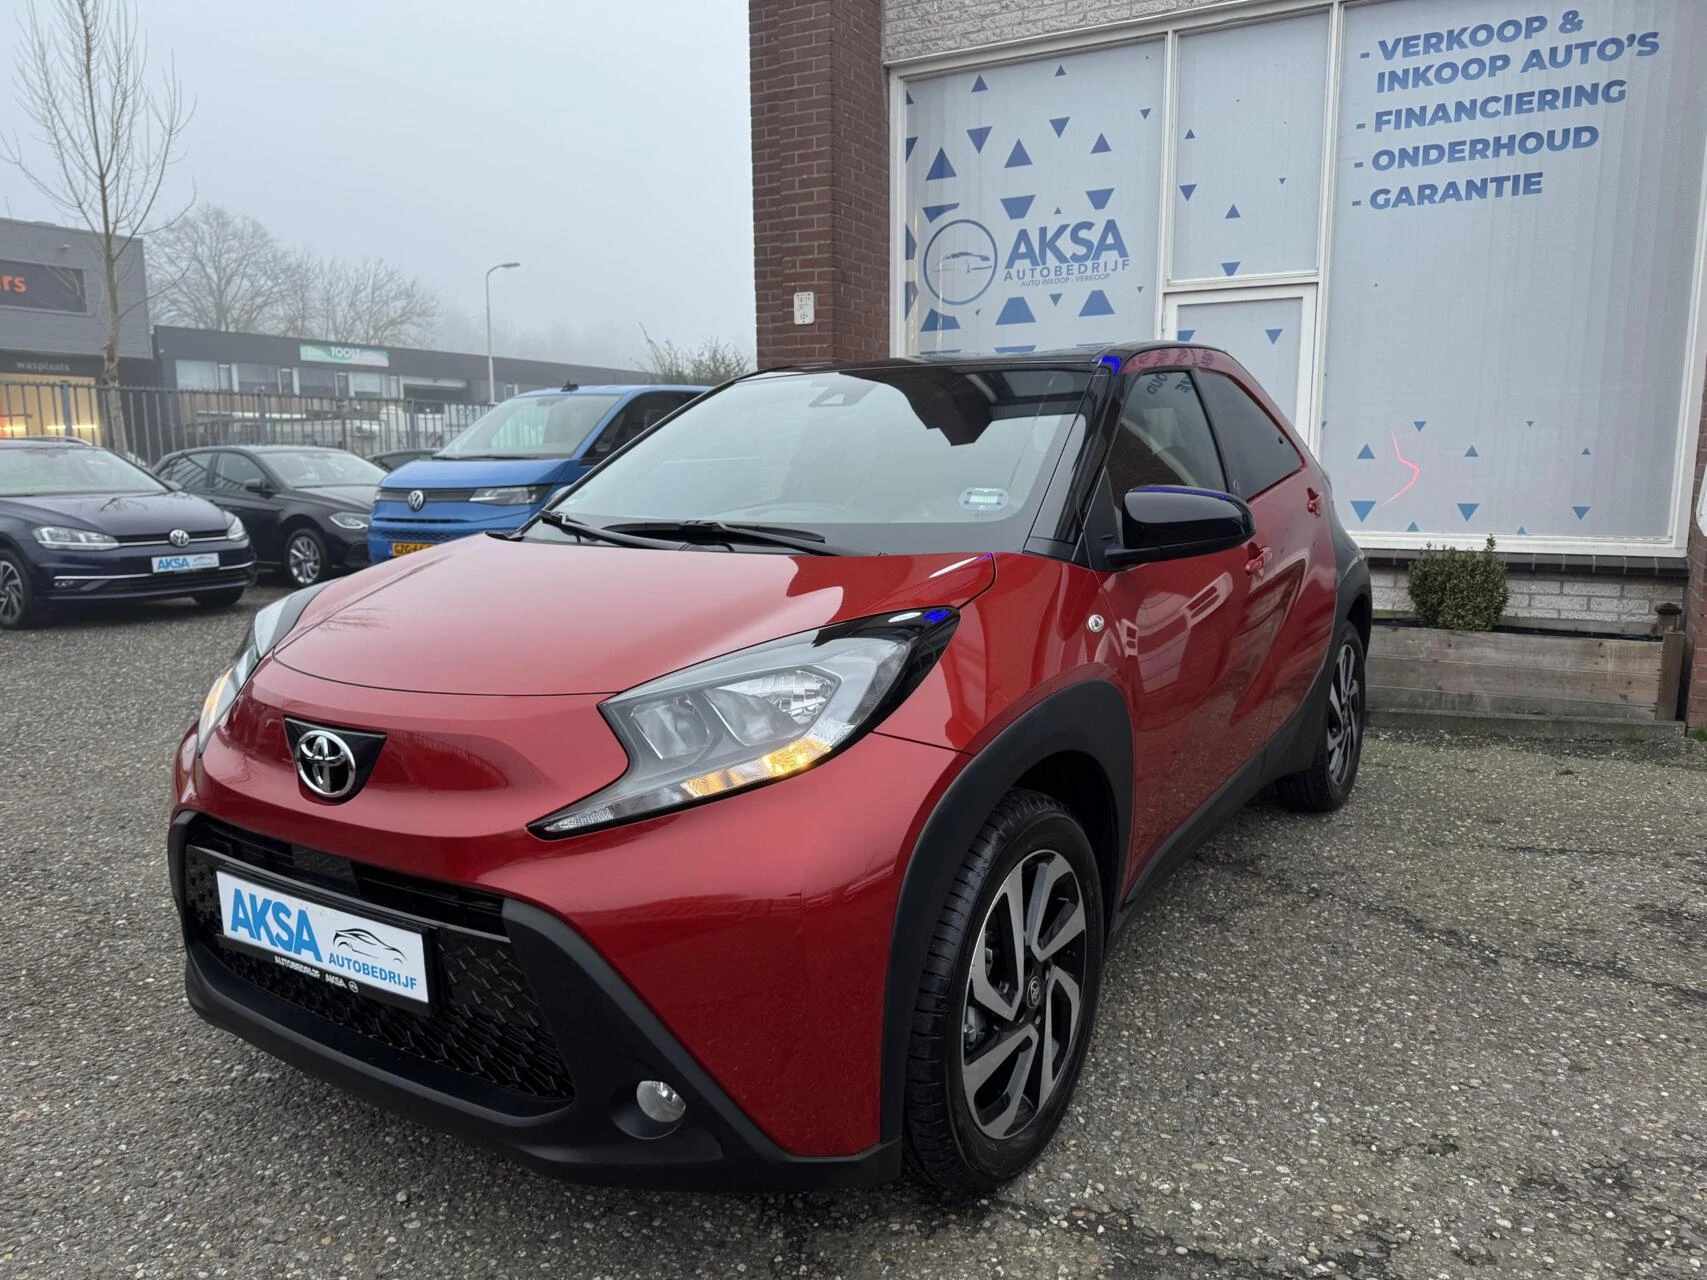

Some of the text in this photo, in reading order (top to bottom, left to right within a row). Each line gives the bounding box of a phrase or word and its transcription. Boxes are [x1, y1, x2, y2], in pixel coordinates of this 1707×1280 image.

[1378, 15, 1548, 61] VERKOOP
[1558, 9, 1584, 34] &
[1376, 31, 1660, 94] INKOOP AUTO'S
[1374, 79, 1627, 133] FINANCIERING
[1371, 125, 1599, 171] ONDERHOUD
[1369, 172, 1544, 210] GARANTIE
[1004, 218, 1129, 270] AKSA
[0, 275, 27, 292] rs
[1003, 259, 1130, 282] AUTOBEDRIJF
[1021, 279, 1041, 288] AUTO
[1042, 276, 1070, 286] INKOOP
[1074, 273, 1111, 283] VERKOOP
[157, 558, 190, 570] AKSA
[231, 888, 323, 963] AKSA
[325, 973, 347, 989] AKSA
[328, 952, 417, 990] AUTOBEDRIJF
